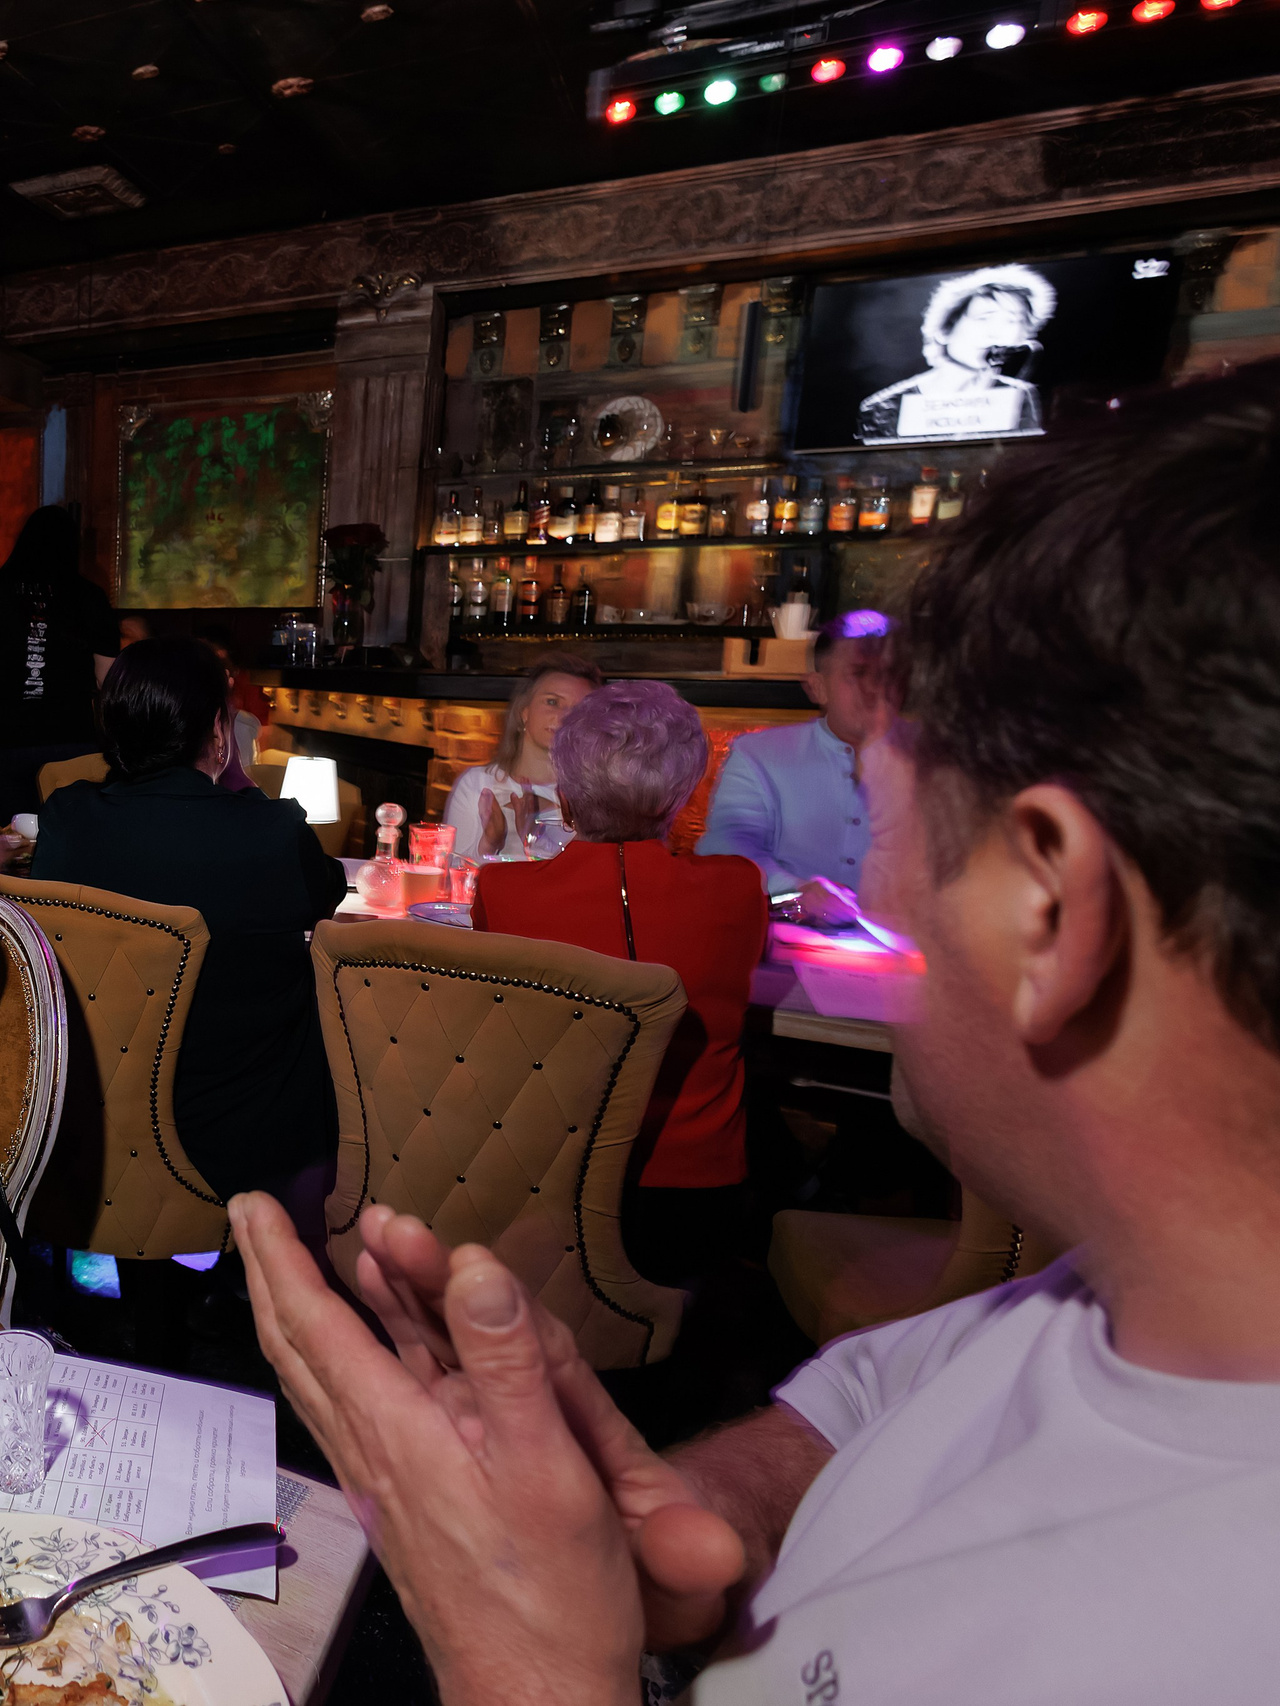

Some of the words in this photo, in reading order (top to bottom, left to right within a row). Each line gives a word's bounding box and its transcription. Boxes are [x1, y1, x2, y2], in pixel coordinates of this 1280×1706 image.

[185, 1522, 193, 1535] Вам
[194, 1435, 202, 1458] собрать
[205, 1498, 213, 1512] Если
